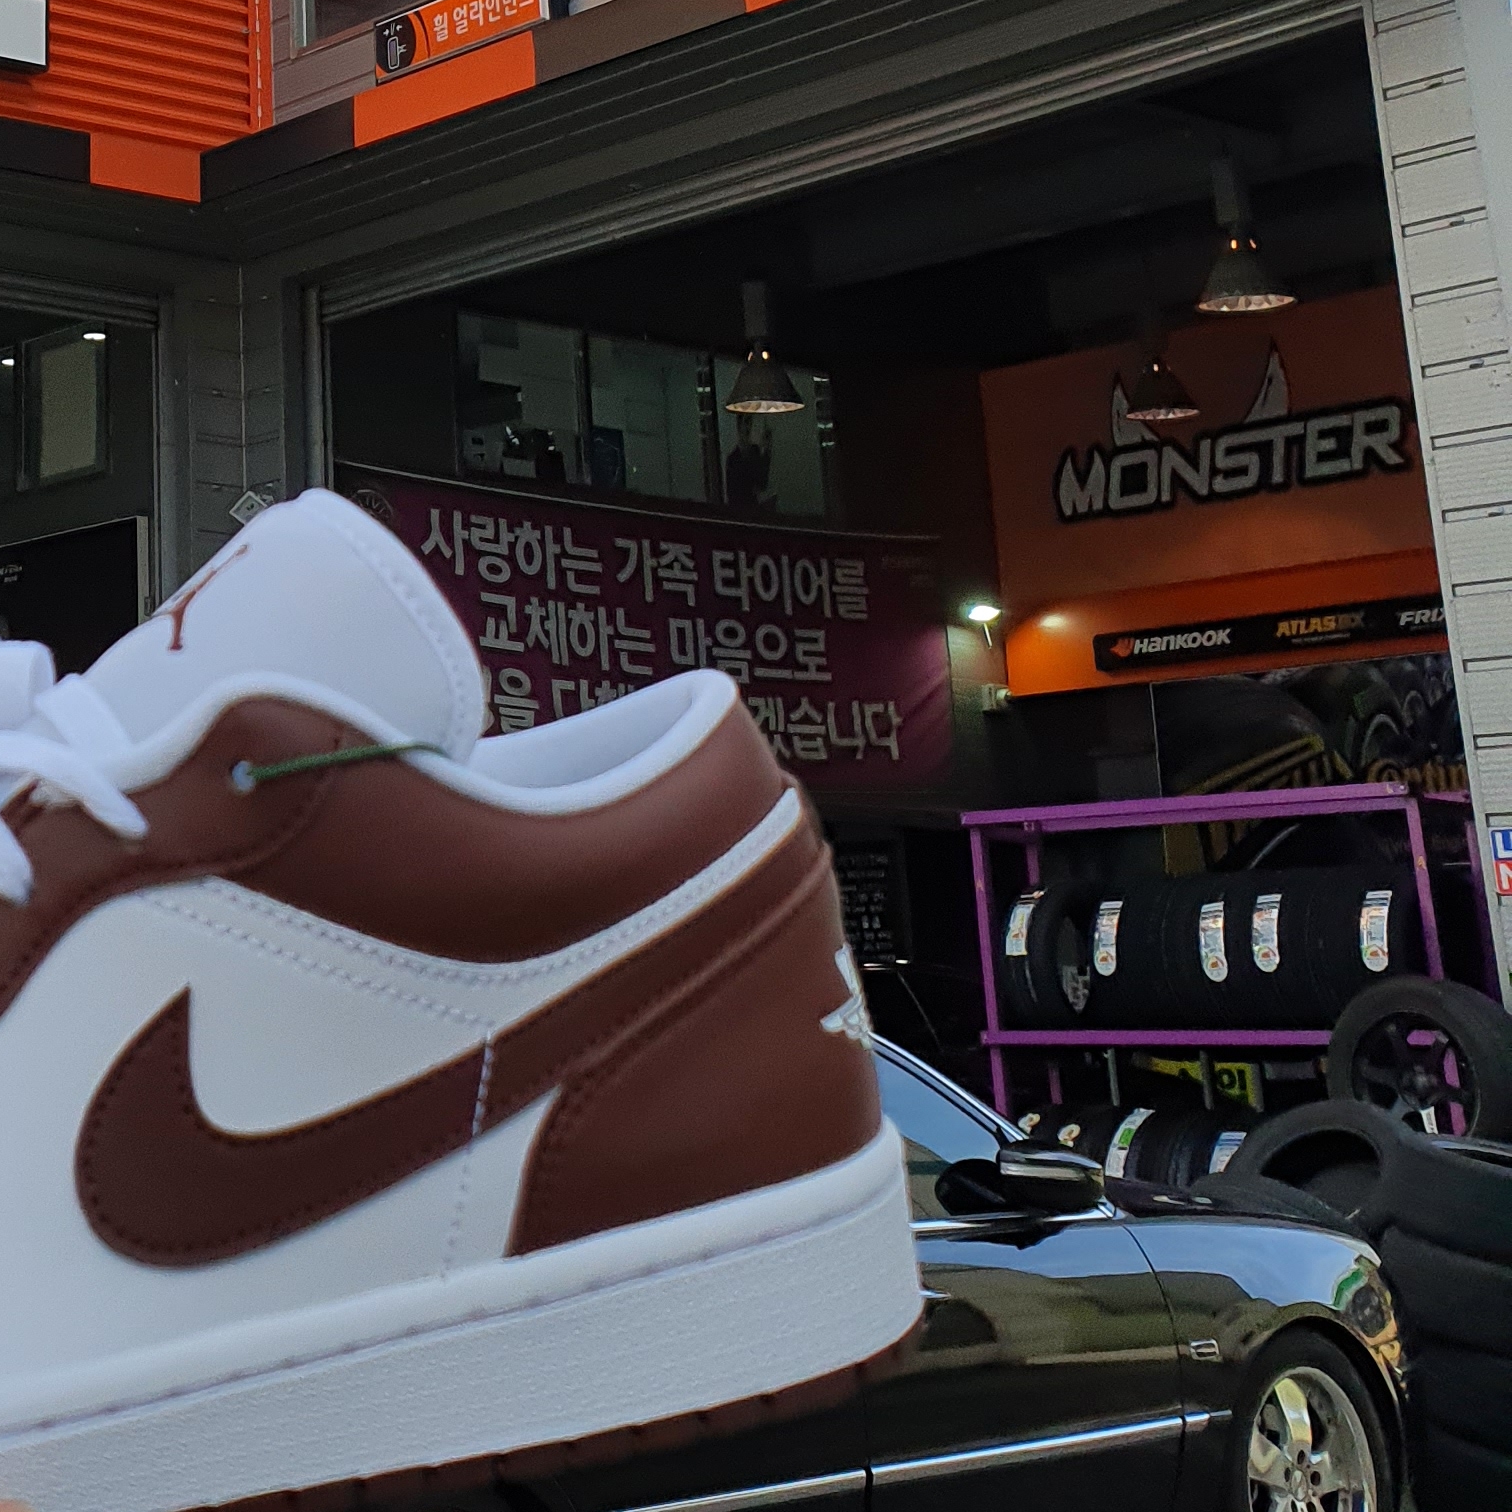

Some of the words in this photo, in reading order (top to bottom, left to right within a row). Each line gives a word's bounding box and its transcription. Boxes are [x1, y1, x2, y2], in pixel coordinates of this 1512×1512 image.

[1059, 402, 1406, 518] MONSTER
[421, 508, 603, 595] 사랑하는
[615, 537, 699, 607] 가족
[713, 549, 870, 621] 타이어를
[478, 591, 657, 676] 교체하는
[669, 618, 833, 685] 마음으로
